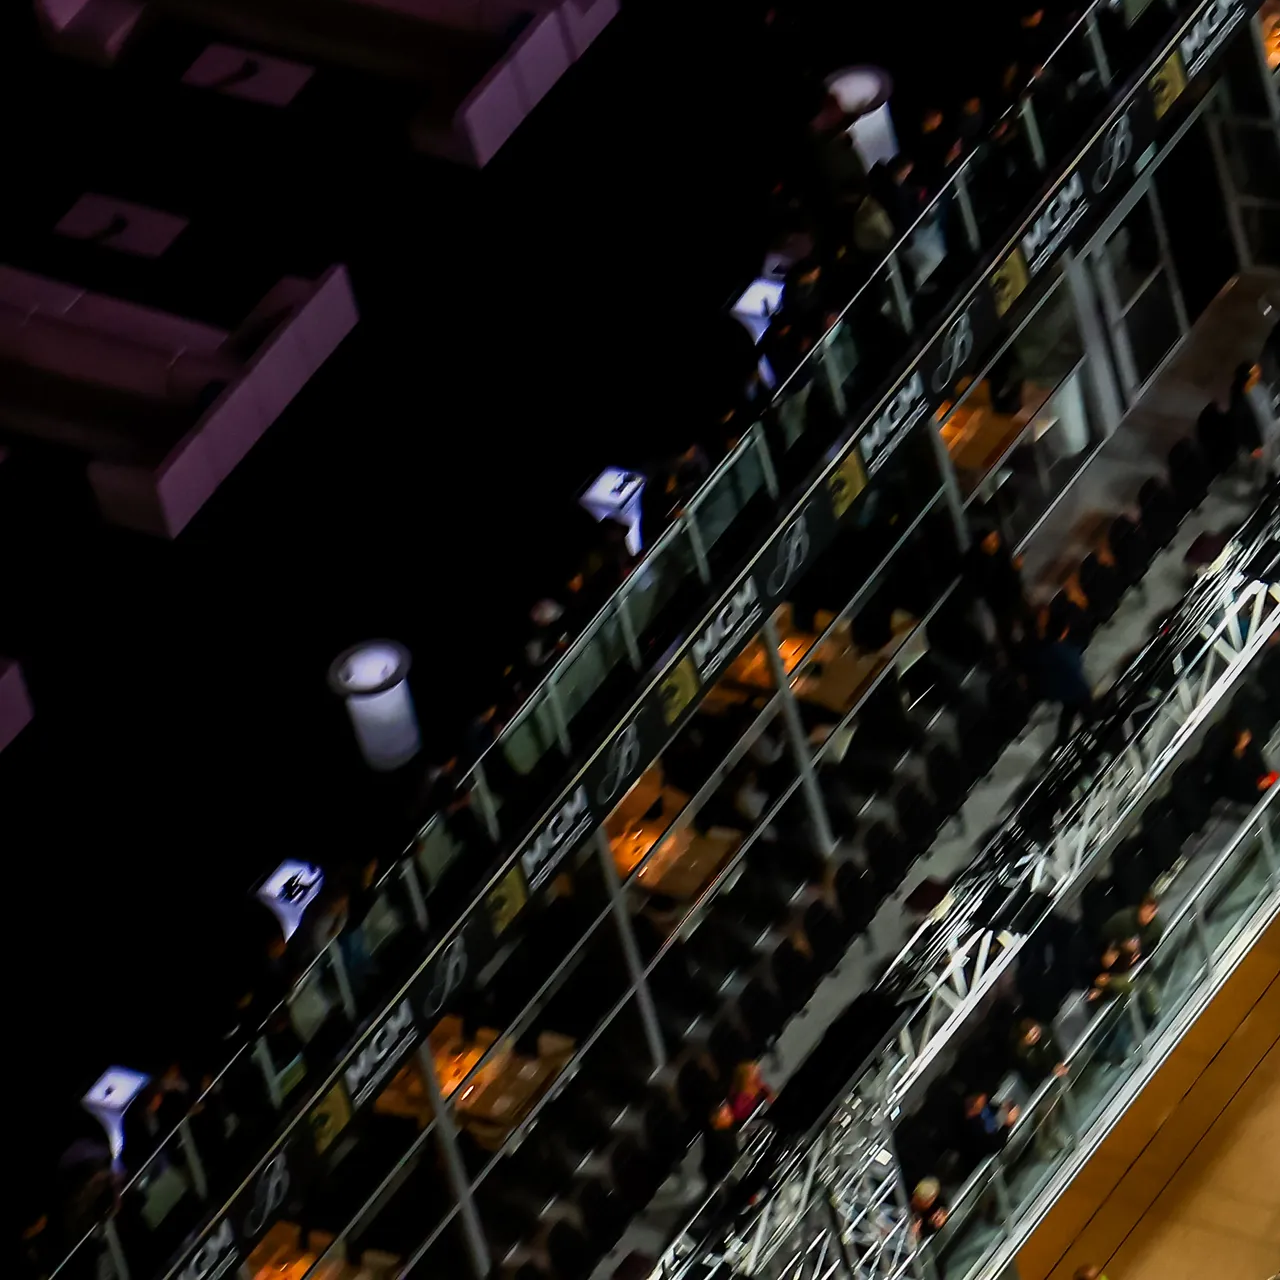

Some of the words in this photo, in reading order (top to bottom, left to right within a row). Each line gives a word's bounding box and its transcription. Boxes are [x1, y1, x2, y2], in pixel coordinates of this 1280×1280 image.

[1022, 171, 1084, 261] MGM
[859, 371, 924, 463] MGM
[691, 575, 760, 669] MGM
[521, 785, 591, 878] MGM
[344, 998, 414, 1095] MGM
